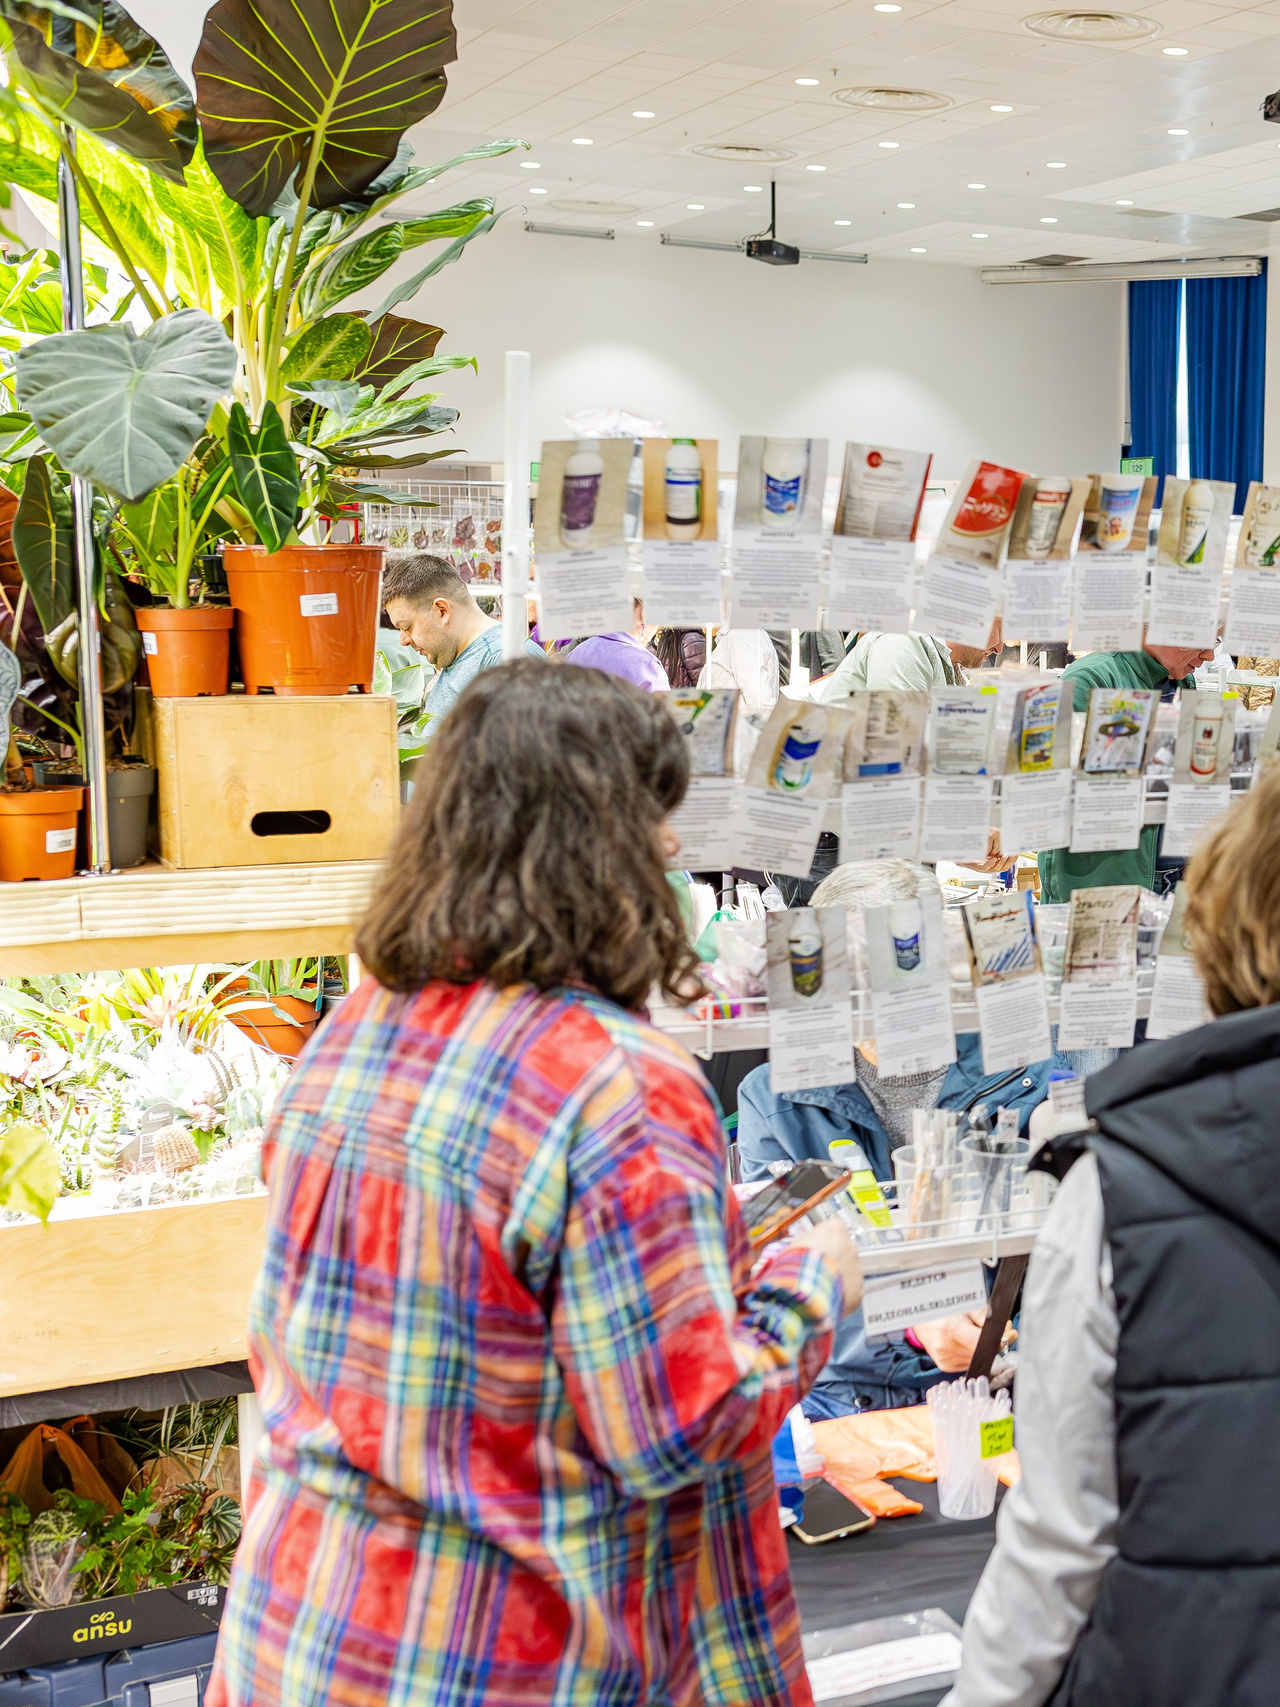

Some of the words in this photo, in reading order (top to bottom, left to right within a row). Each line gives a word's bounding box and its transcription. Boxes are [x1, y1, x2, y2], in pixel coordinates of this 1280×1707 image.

[1132, 464, 1144, 473] 129
[899, 1271, 947, 1290] ВЕДЕТСЯ
[72, 1618, 133, 1643] ansu
